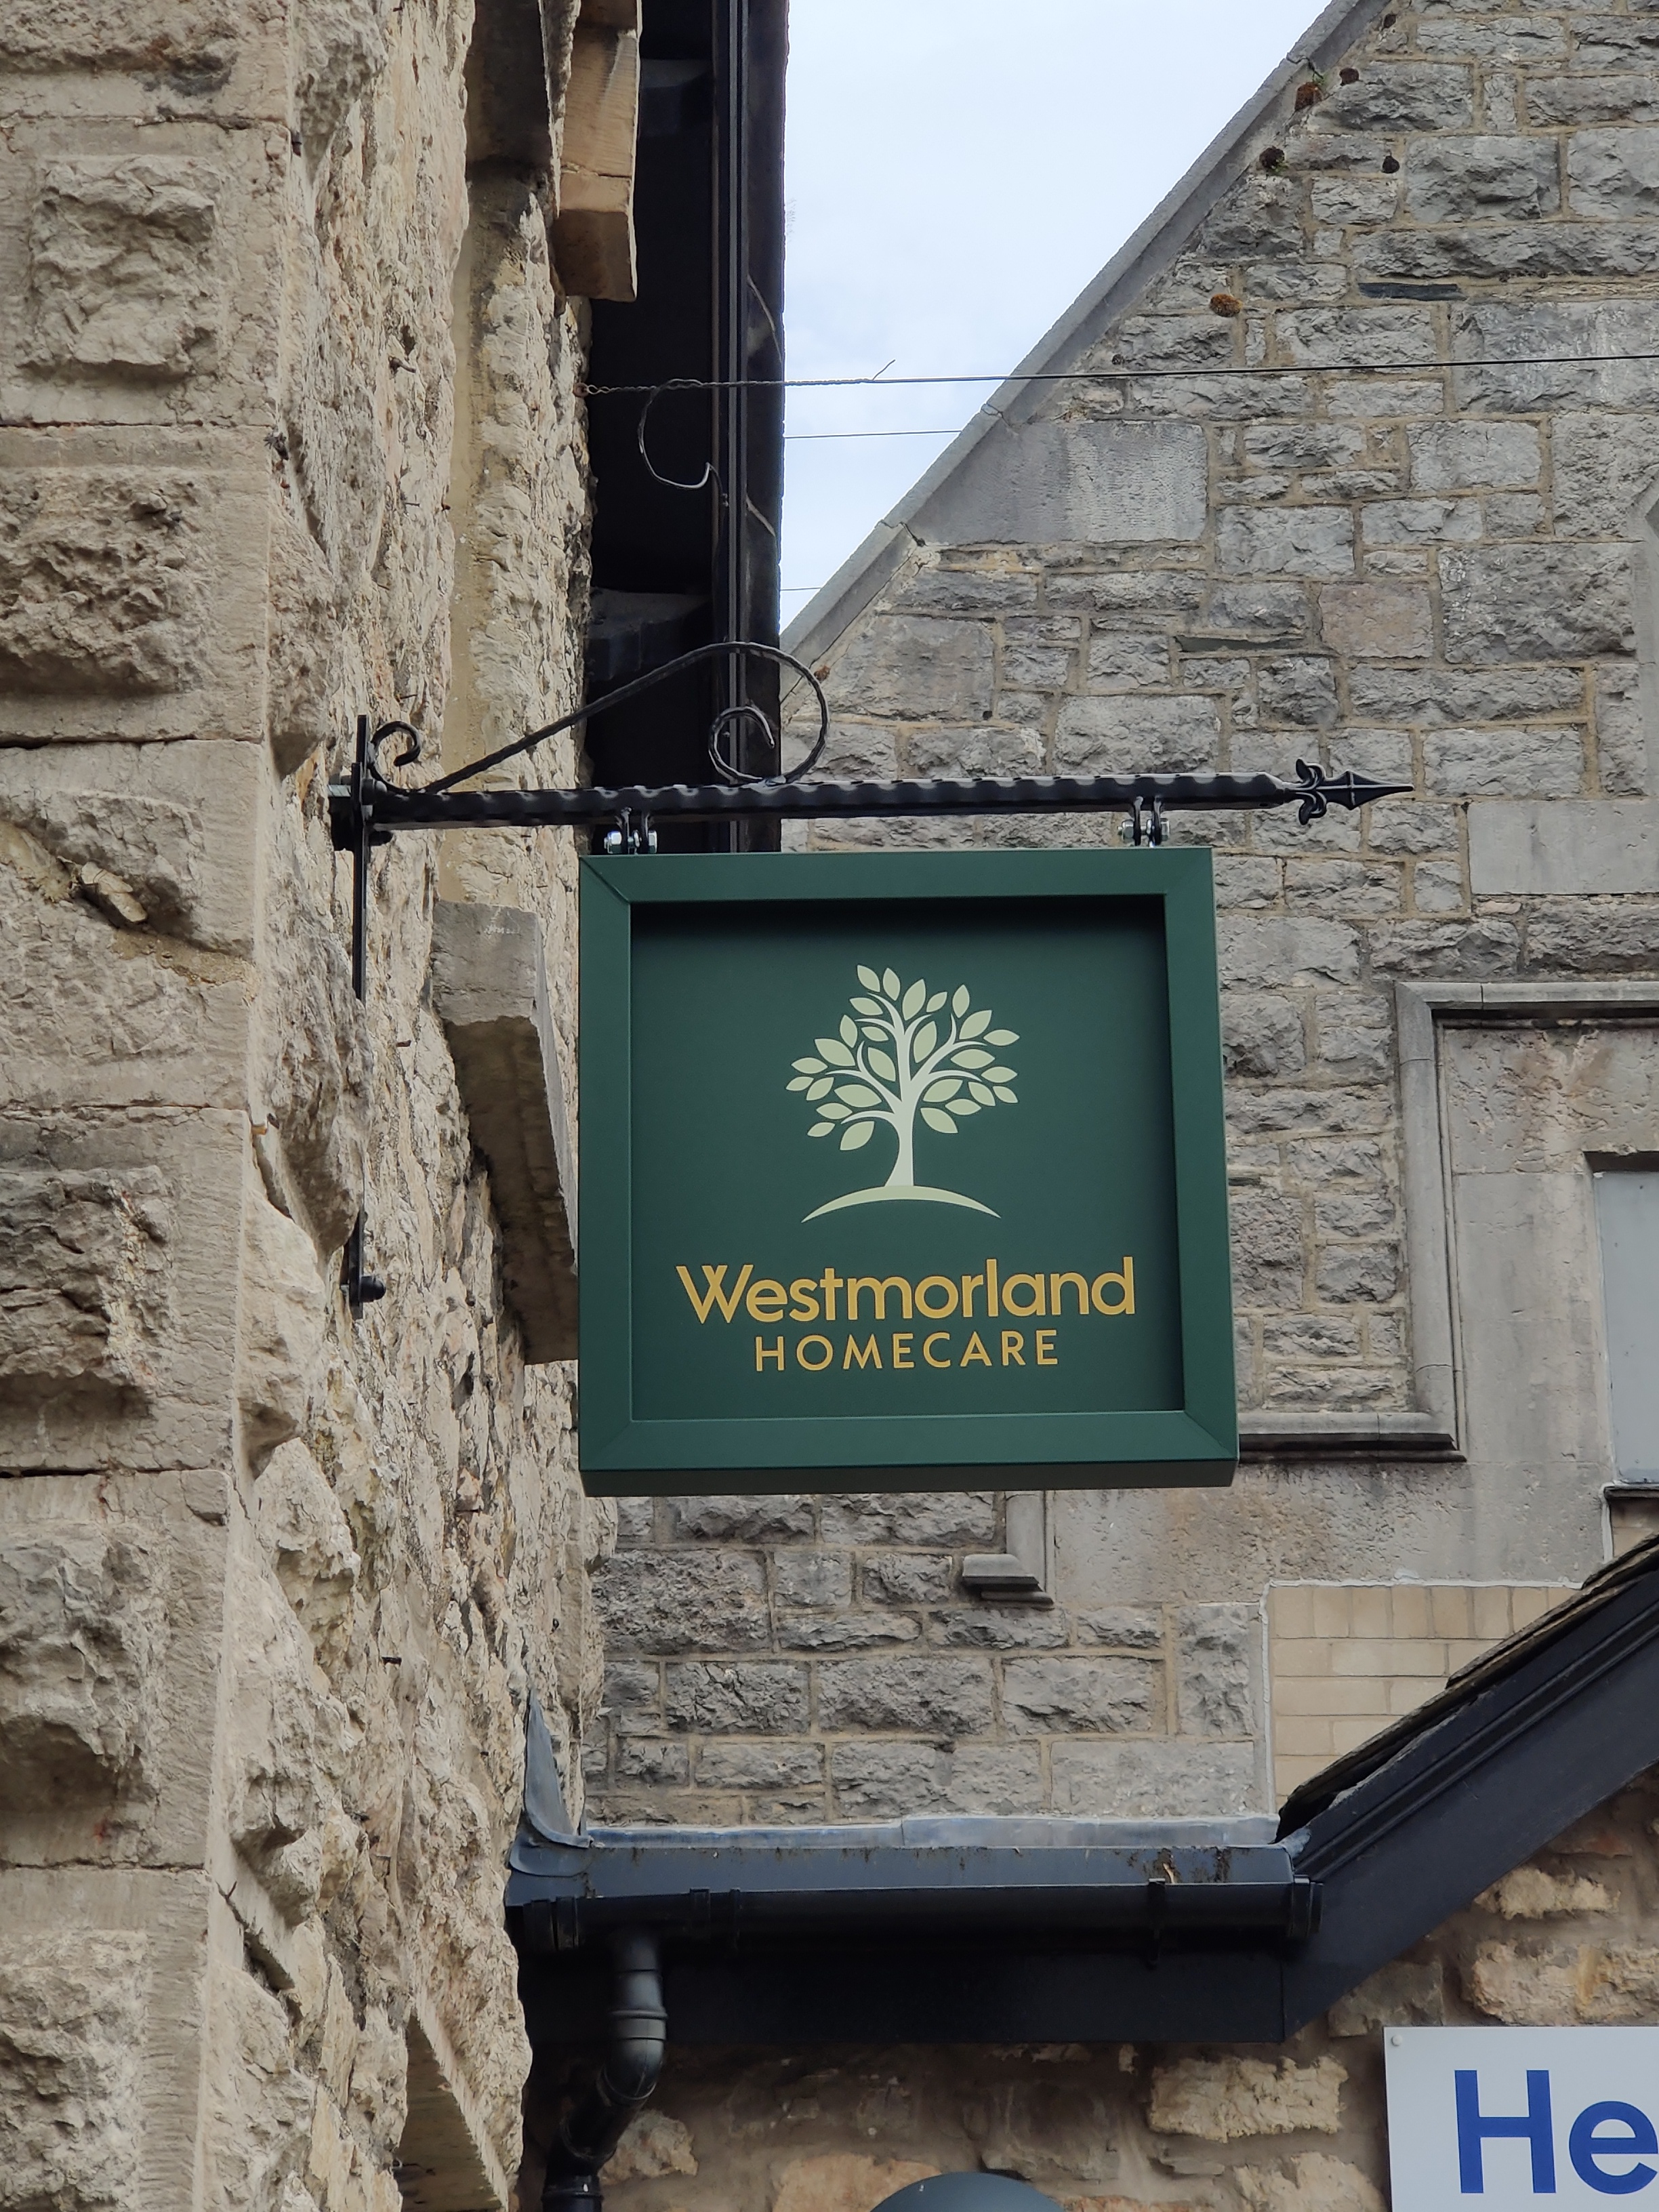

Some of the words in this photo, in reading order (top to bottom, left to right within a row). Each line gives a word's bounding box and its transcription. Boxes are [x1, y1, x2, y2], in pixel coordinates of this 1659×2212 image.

[676, 1256, 1136, 1324] Westmorland
[755, 1329, 1059, 1372] HOMECARE
[1454, 2069, 1659, 2195] He
